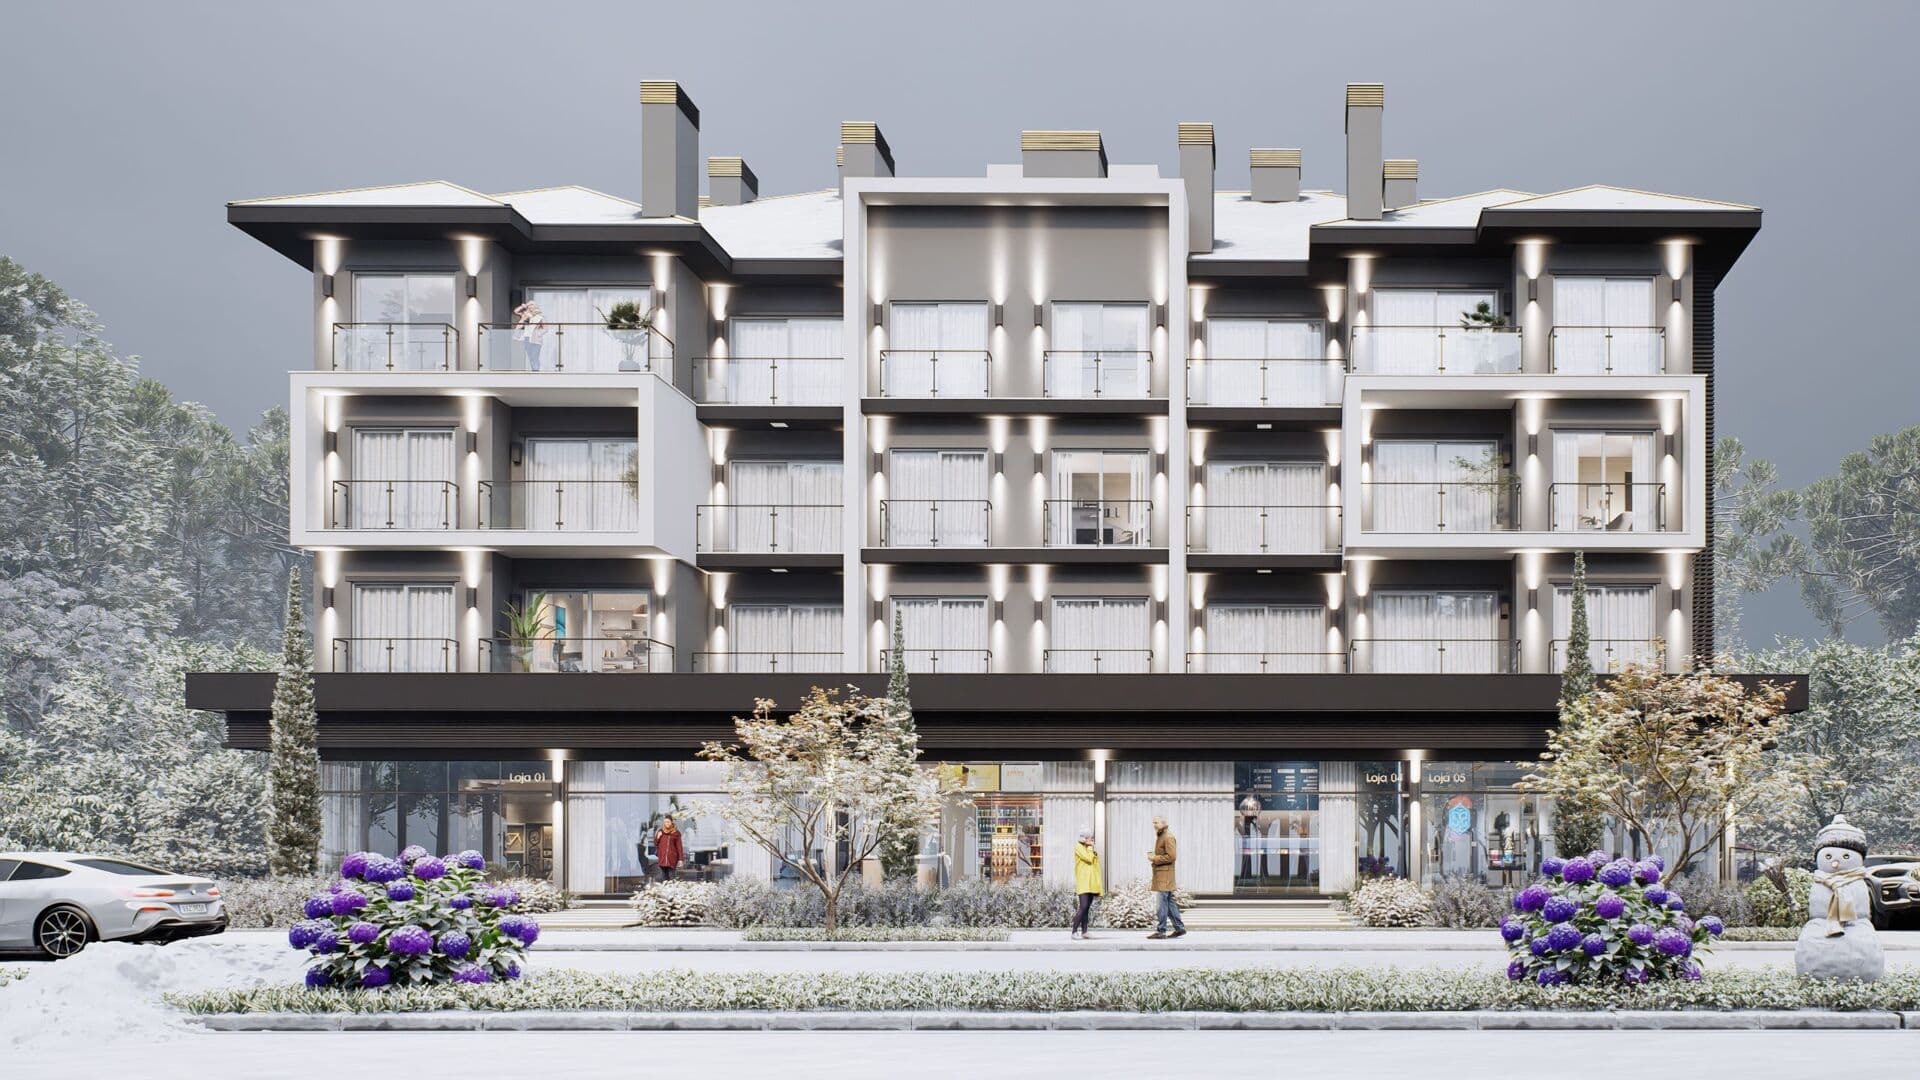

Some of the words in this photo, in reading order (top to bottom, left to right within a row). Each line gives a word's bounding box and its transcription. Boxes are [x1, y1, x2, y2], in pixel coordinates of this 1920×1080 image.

[509, 772, 531, 784] Loja
[534, 772, 545, 782] 01
[1366, 773, 1387, 784] Loja
[1391, 773, 1404, 783] 04
[1429, 773, 1450, 784] Loja
[1453, 773, 1466, 783] 05
